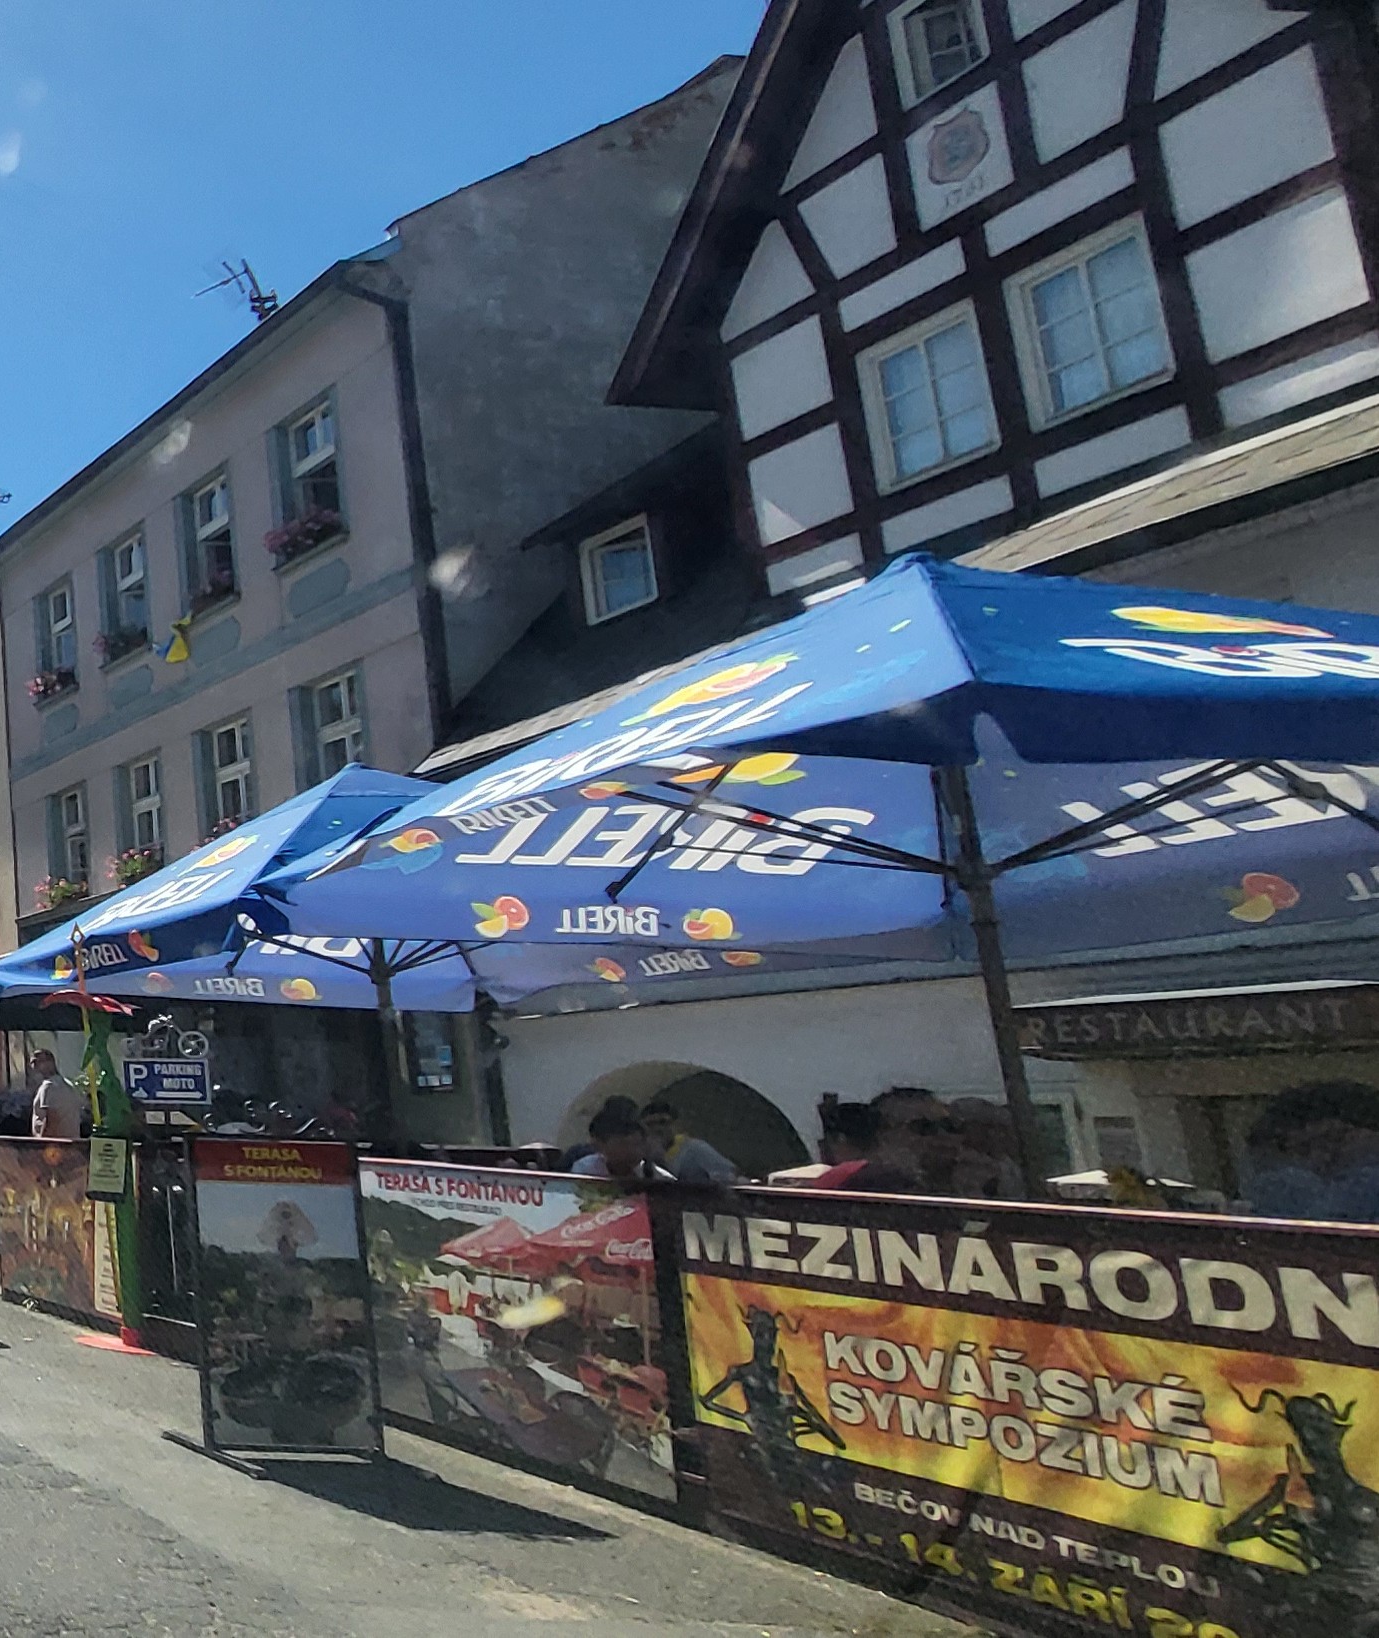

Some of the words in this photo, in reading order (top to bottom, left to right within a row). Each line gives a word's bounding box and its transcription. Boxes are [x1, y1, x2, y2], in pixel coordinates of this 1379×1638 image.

[1024, 1000, 1347, 1043] RESTAURANT
[129, 1064, 148, 1088] P
[153, 1063, 202, 1076] PARKING
[163, 1077, 195, 1090] MOTO
[224, 1164, 234, 1177] S
[242, 1147, 301, 1161] TERASA
[375, 1172, 431, 1194] TERASA
[435, 1178, 444, 1196] S
[681, 1211, 1379, 1347] MEZINÁRODN
[824, 1330, 1213, 1442] KOVÁŘSKÉ
[828, 1382, 1225, 1507] SYMPOZIUM
[854, 1482, 960, 1527] BEČOV
[970, 1515, 1045, 1551] NAD
[1052, 1535, 1221, 1598] TEPLOU
